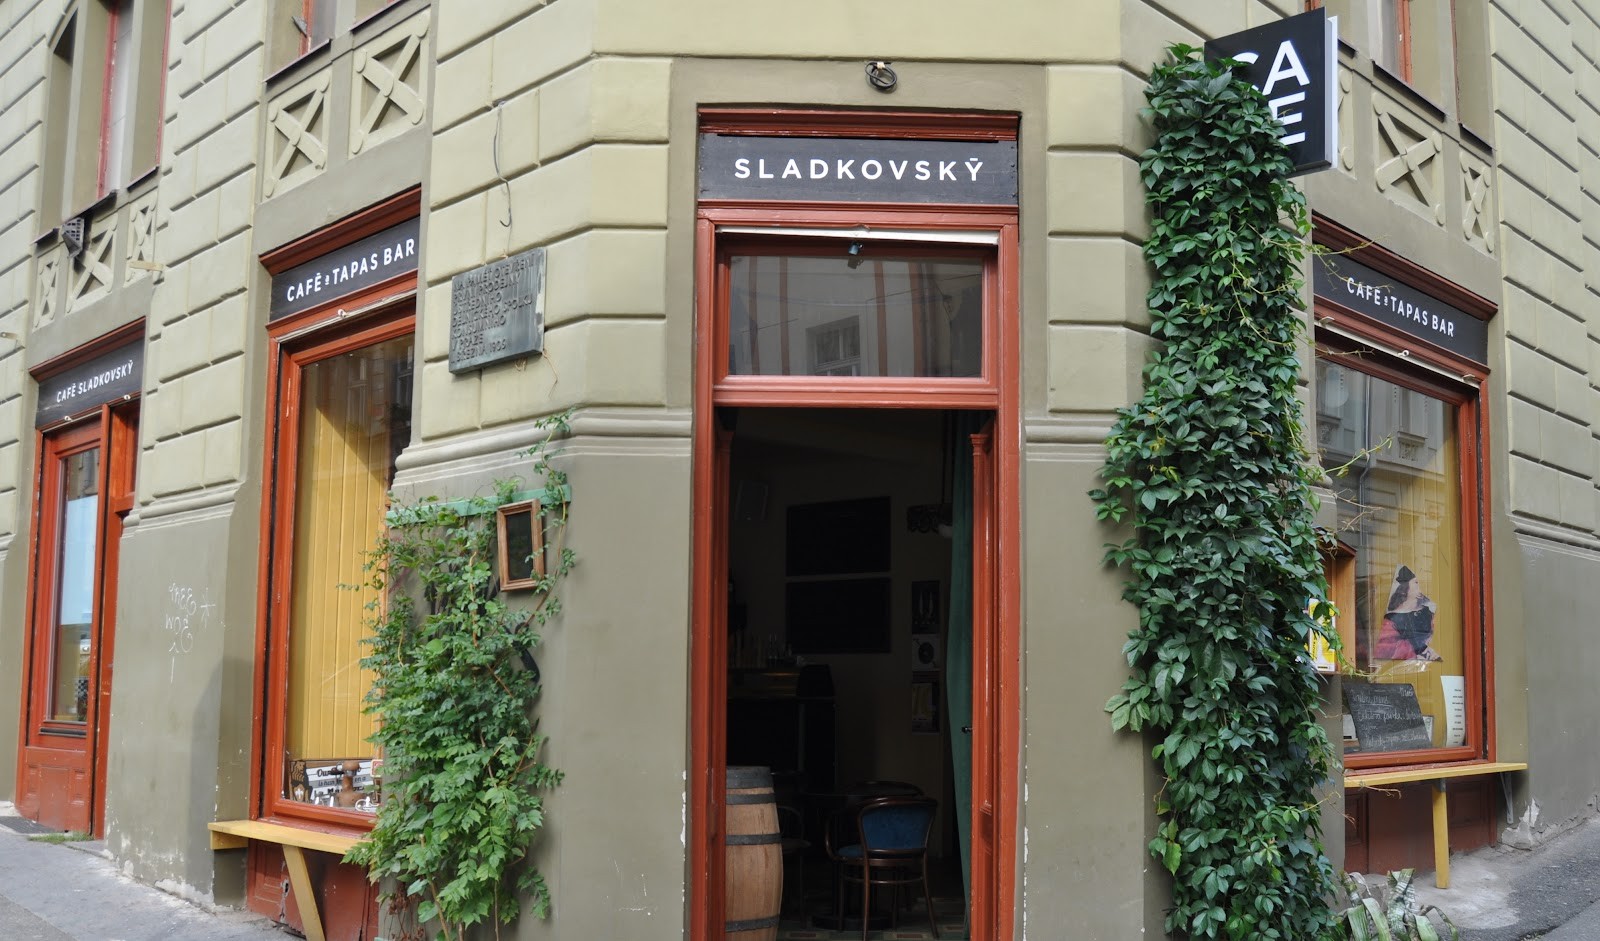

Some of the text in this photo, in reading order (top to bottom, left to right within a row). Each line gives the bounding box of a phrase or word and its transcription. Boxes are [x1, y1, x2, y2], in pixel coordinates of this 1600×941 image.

[332, 252, 379, 285] TAPAS
[383, 238, 415, 266] BAR
[1390, 296, 1429, 326] TAPAS
[1432, 315, 1455, 338] BAR
